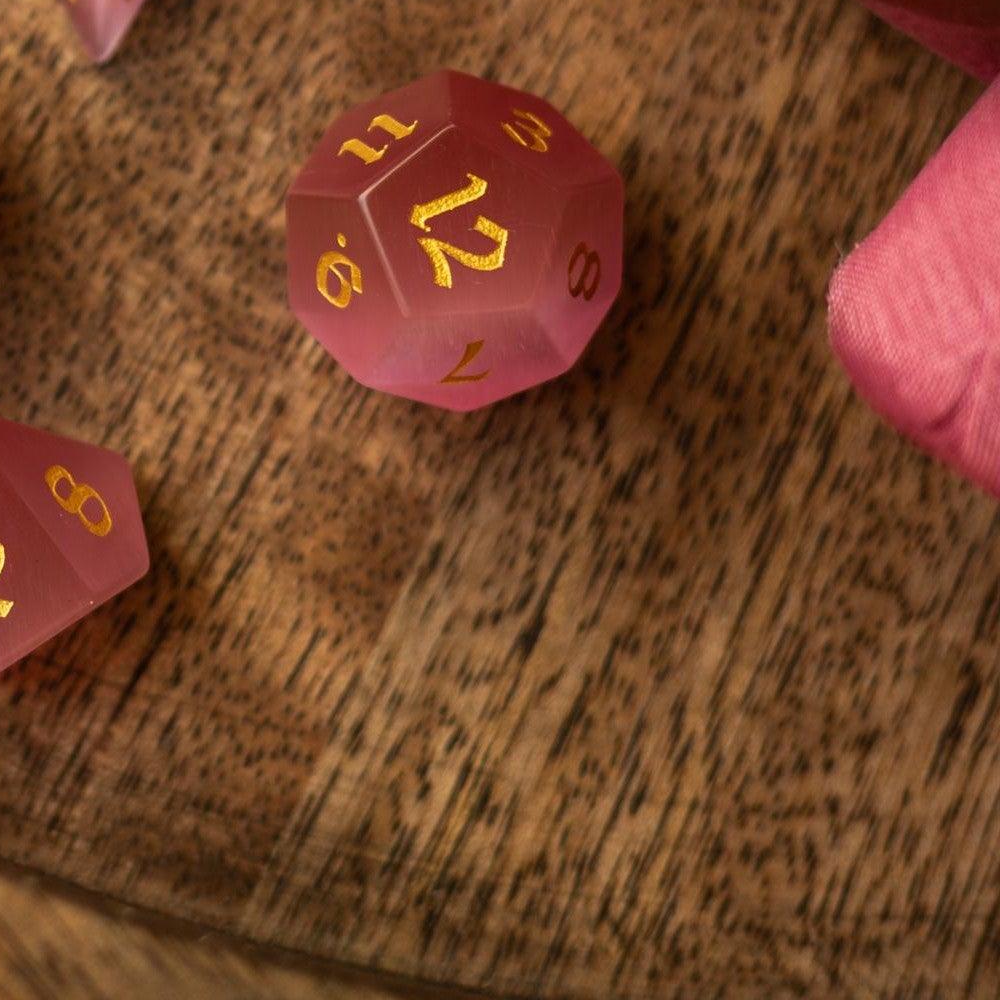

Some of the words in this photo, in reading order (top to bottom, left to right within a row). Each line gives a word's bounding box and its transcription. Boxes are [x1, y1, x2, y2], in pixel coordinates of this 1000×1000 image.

[337, 113, 419, 166] 11
[409, 172, 509, 290] 12
[567, 241, 601, 302] 8
[440, 339, 491, 385] 7
[43, 464, 113, 538] 8
